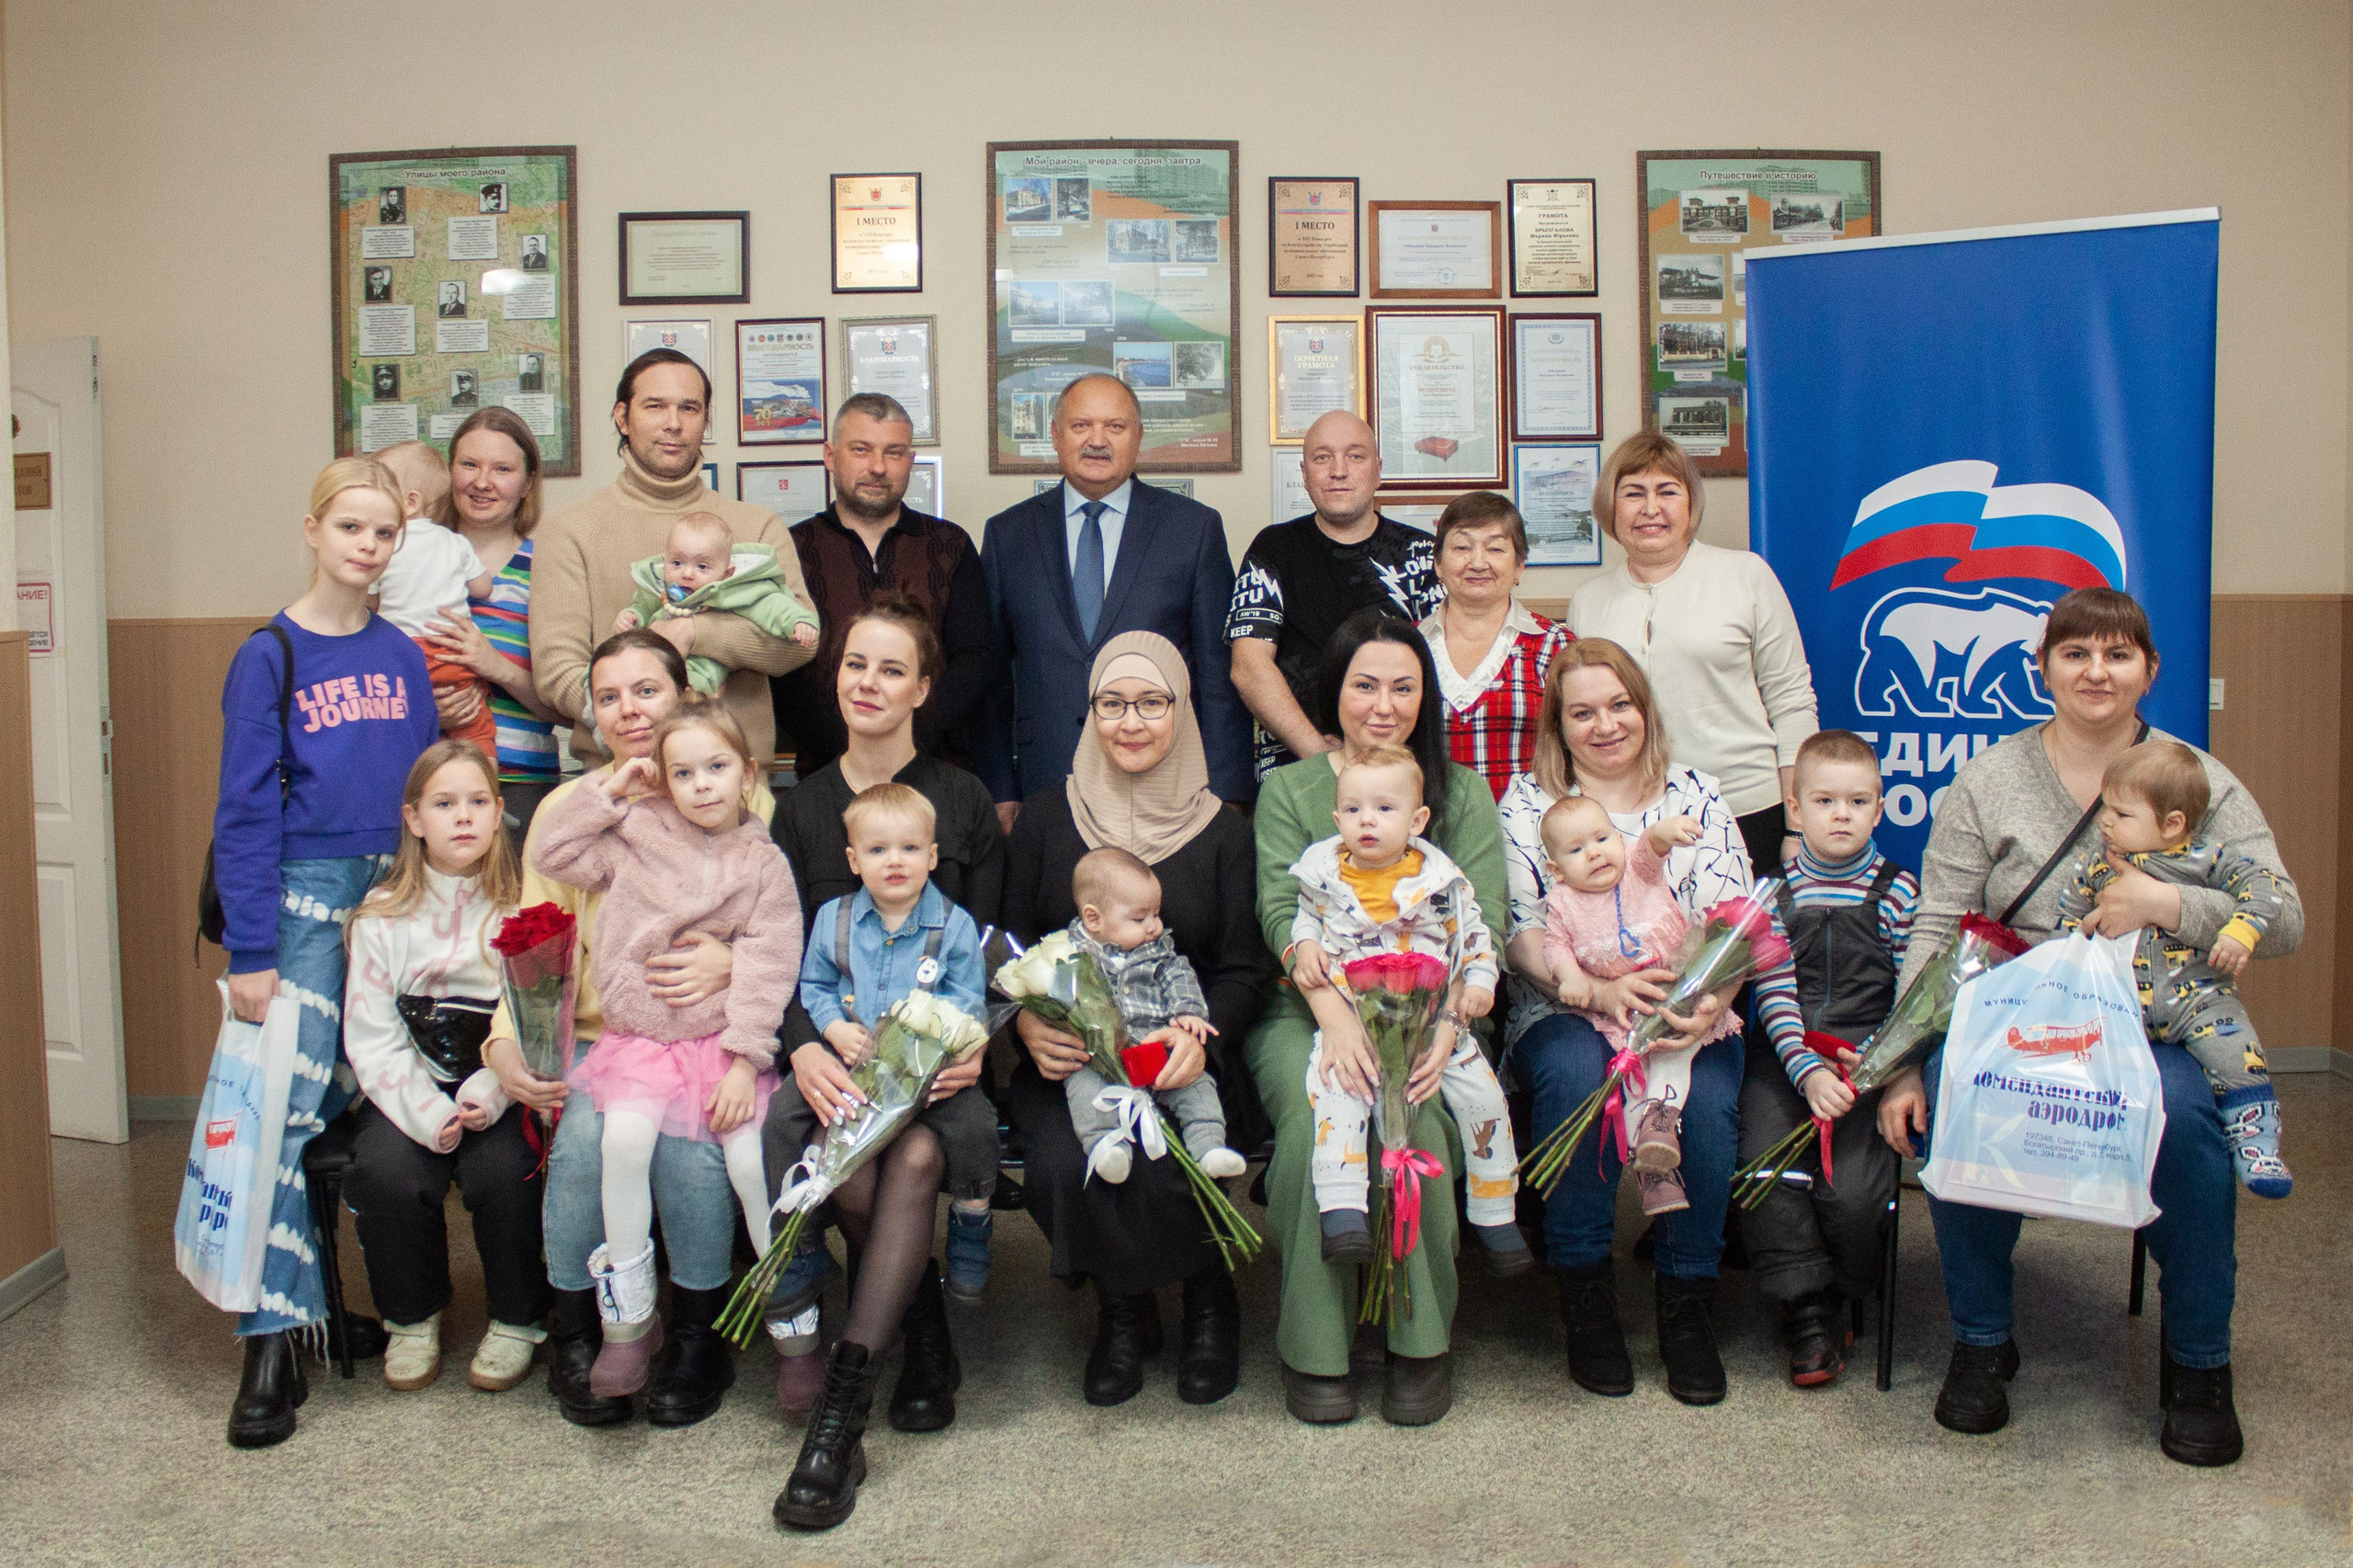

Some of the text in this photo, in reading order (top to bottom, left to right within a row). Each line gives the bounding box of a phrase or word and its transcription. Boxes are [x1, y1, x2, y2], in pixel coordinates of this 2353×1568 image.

[1025, 155, 1048, 165] Мой
[1049, 156, 1080, 166] район
[1088, 158, 1120, 166] вчера,
[1122, 158, 1165, 166] сегодня,
[1167, 157, 1201, 165] завтра
[404, 170, 438, 179] Улицы
[439, 169, 469, 177] моего
[1699, 170, 1763, 181] Путешествие
[1773, 172, 1816, 181] историю
[862, 217, 896, 225] МЕСТО
[1301, 222, 1336, 230] МЕСТО
[753, 408, 772, 421] 70
[1230, 625, 1254, 639] KEEP
[295, 676, 361, 712] LIFE
[363, 673, 391, 698] IS
[2025, 1131, 2055, 1143] 197348,
